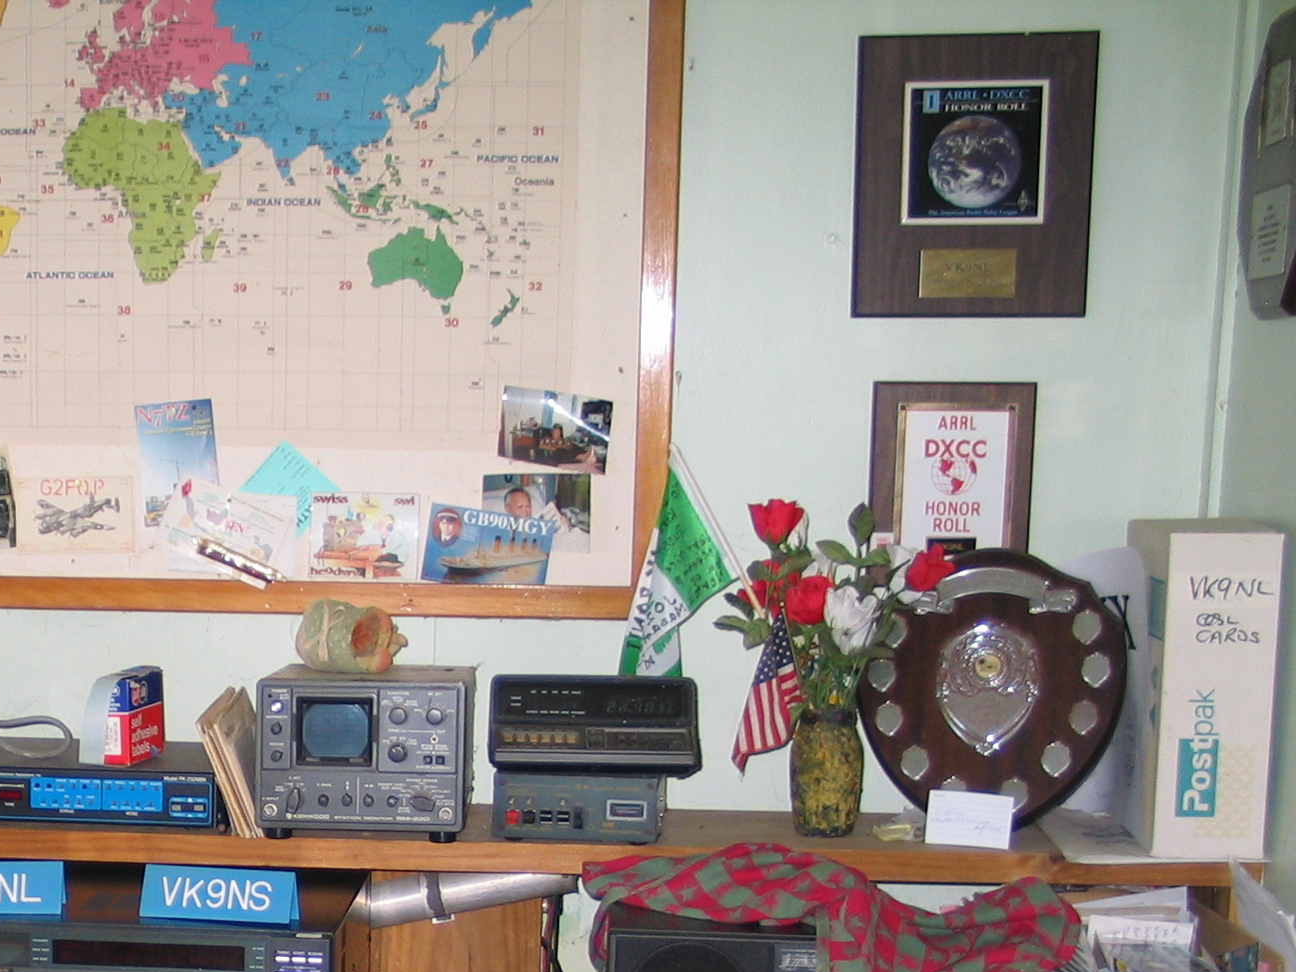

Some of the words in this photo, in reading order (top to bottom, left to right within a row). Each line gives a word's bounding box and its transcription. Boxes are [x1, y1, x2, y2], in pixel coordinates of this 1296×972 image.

[366, 25, 388, 34] Asia
[64, 79, 75, 88] 14
[944, 90, 980, 100] ARRL
[989, 89, 1029, 100] DXCC
[944, 102, 992, 112] HONOR
[996, 102, 1029, 111] ROLL
[368, 110, 382, 120] 24
[32, 119, 46, 128] 33
[0, 128, 36, 136] OCEAN
[532, 126, 545, 136] 31
[157, 142, 170, 151] 34
[420, 159, 434, 168] 27
[477, 154, 518, 163] PACIFIC
[521, 154, 559, 164] OCEAN
[514, 177, 554, 186] Oceania
[41, 185, 54, 194] 35
[246, 198, 282, 206] INDIAN
[284, 198, 320, 206] OCEAN
[26, 271, 76, 279] ATLANTIC
[78, 271, 114, 279] OCEAN
[338, 280, 352, 290] 29
[528, 282, 542, 292] 32
[117, 306, 130, 315] 38
[444, 318, 458, 328] 30
[938, 416, 976, 430] ARRL
[924, 439, 988, 458] DXCC
[312, 495, 348, 504] swiss
[925, 502, 980, 516] HONOR
[463, 510, 552, 536] GB90MGY
[932, 518, 970, 532] ROLL
[1190, 576, 1274, 600] VK9NL
[131, 714, 142, 728] self
[131, 724, 158, 742] adhesive
[132, 742, 150, 758] labels
[1182, 689, 1220, 813] Postpak
[160, 876, 273, 912] VK9NS
